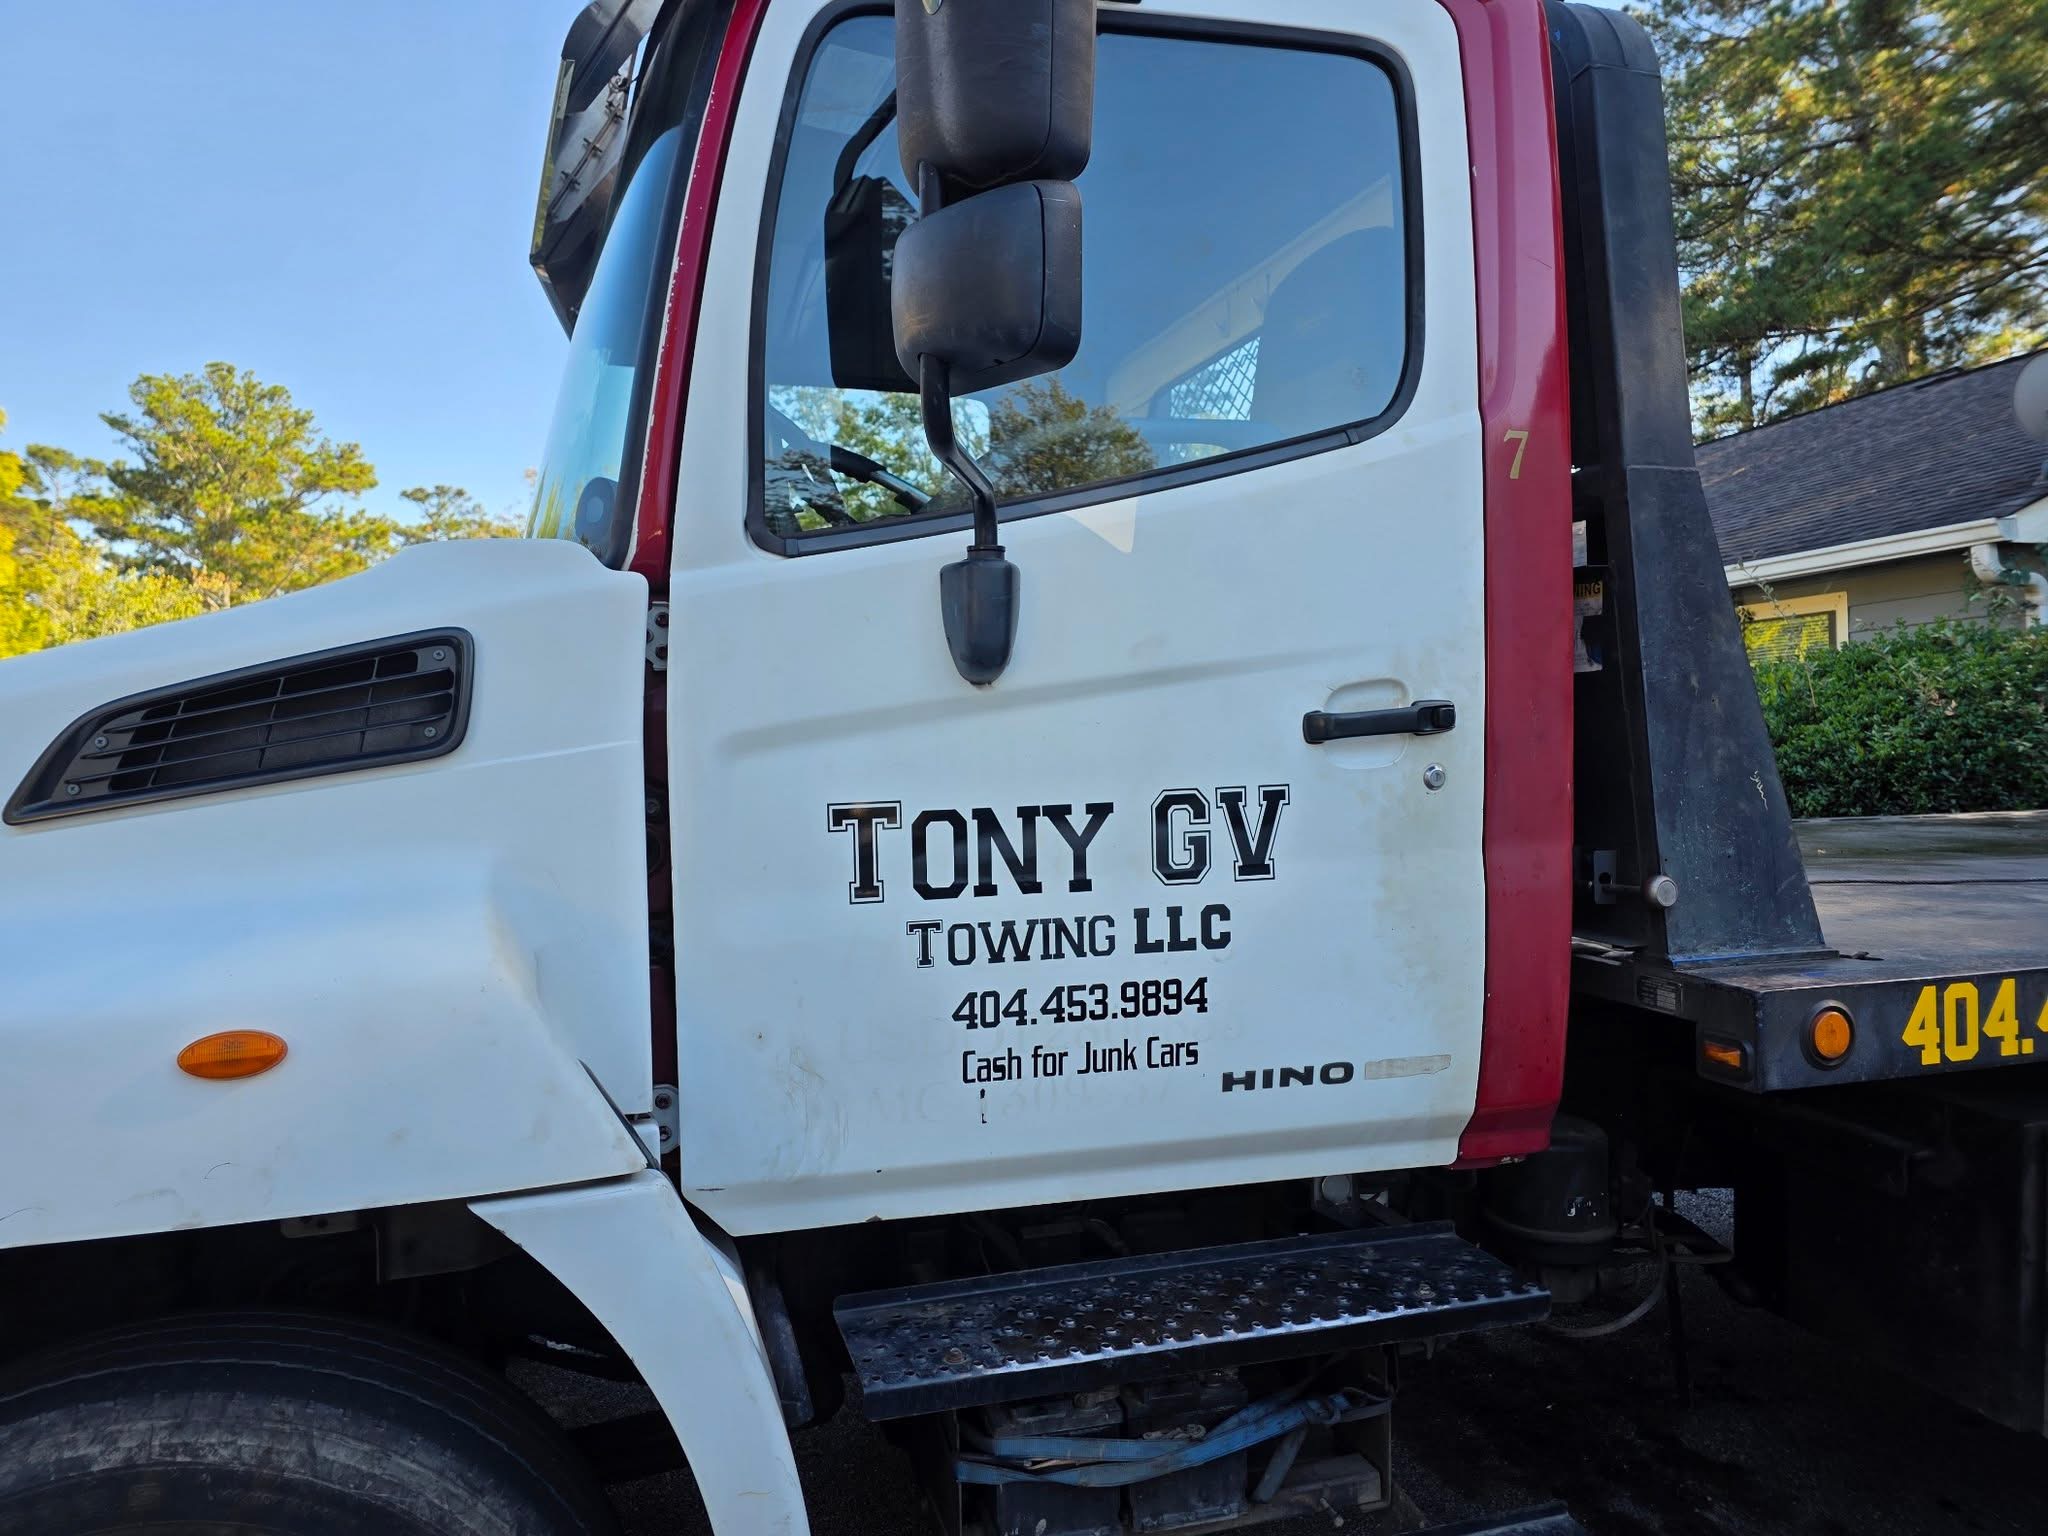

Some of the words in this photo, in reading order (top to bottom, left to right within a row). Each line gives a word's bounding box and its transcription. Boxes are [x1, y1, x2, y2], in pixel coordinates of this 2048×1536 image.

[1503, 428, 1529, 480] 7
[826, 799, 1114, 906] TONY
[1150, 783, 1291, 887] GV
[905, 914, 1116, 968] TOWING
[1133, 903, 1232, 955] LLC
[951, 976, 1208, 1030] 404.453.9894
[962, 1047, 1022, 1084] Cash
[1031, 1044, 1069, 1079] for
[1076, 1038, 1138, 1075] Junk
[1146, 1035, 1199, 1069] Cars
[1221, 1061, 1355, 1093] HINO
